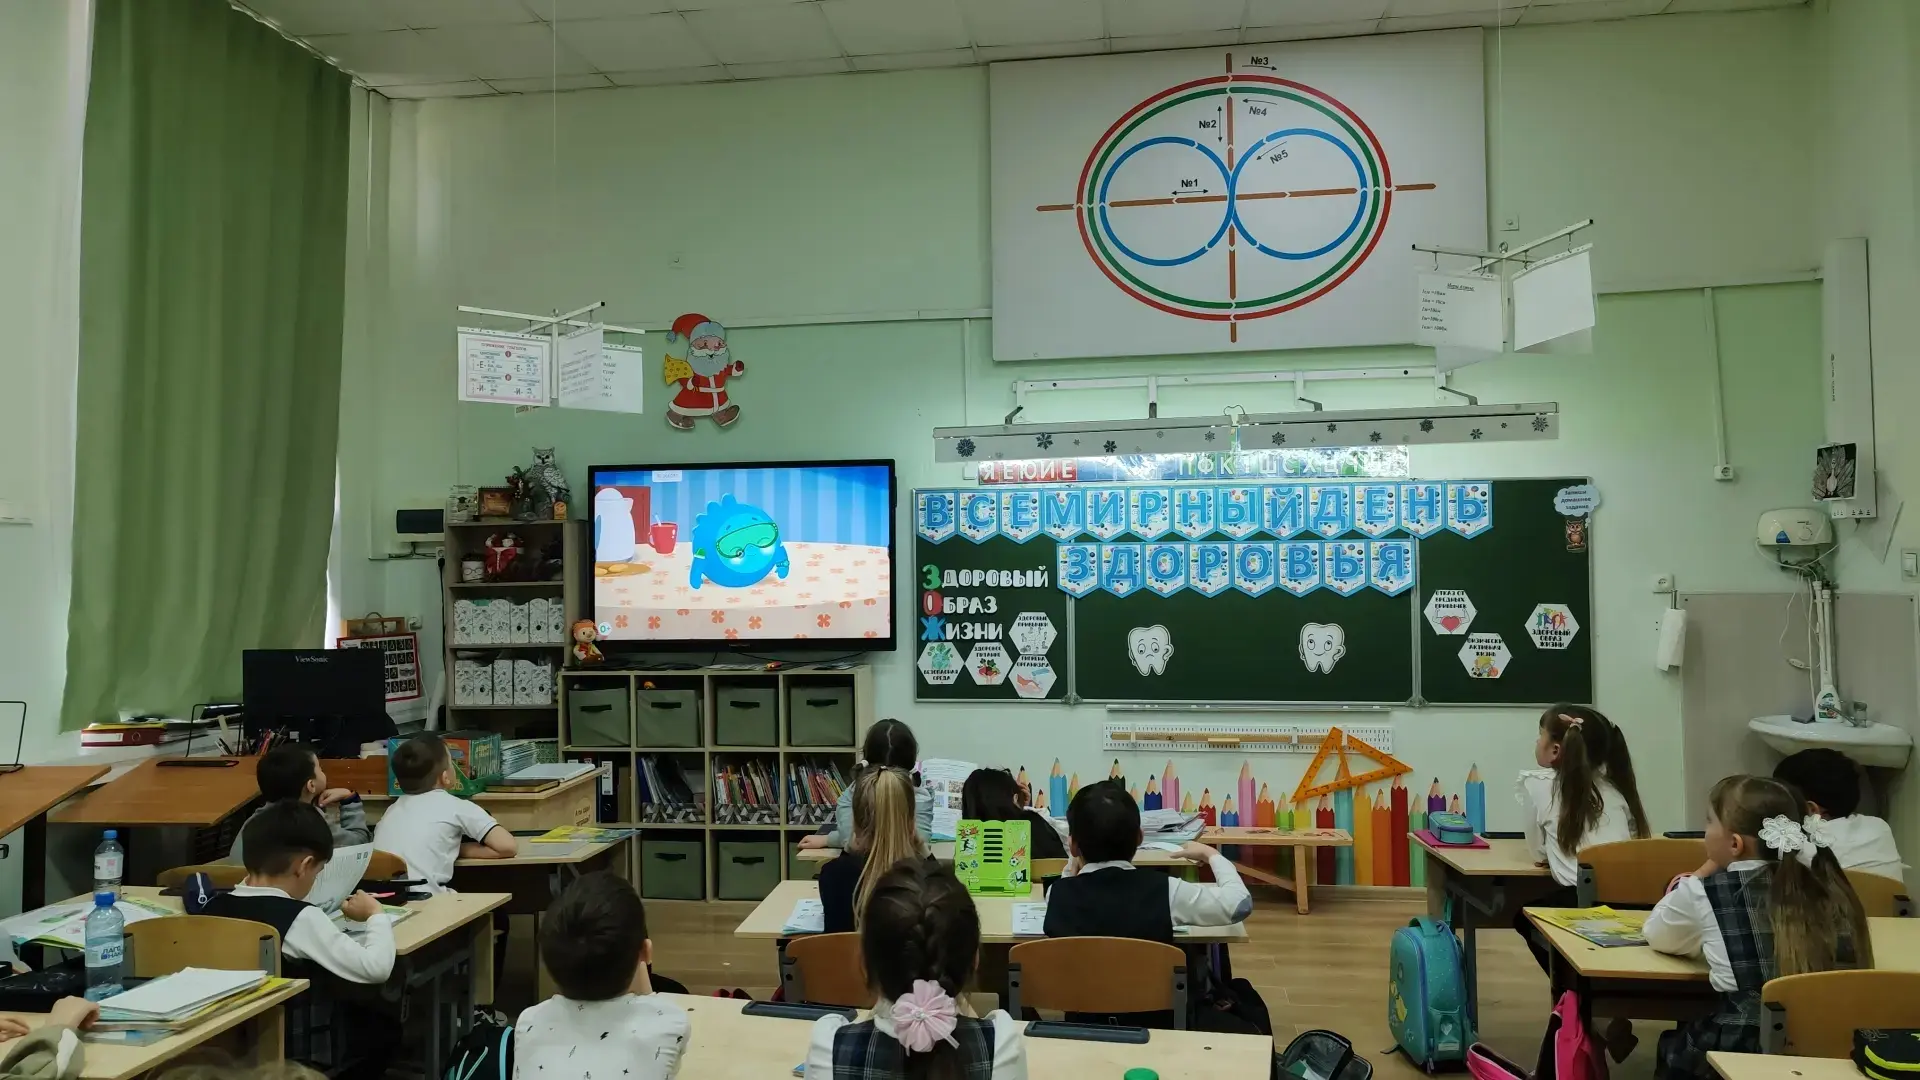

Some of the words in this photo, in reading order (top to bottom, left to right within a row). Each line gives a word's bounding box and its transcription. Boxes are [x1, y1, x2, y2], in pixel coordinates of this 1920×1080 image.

[1250, 56, 1269, 65] №3
[1249, 106, 1267, 116] №4
[1199, 120, 1217, 129] №2
[1269, 150, 1289, 164] №5
[1181, 179, 1199, 188] №1
[1065, 545, 1406, 589] ЗДОРОВЬЯ
[922, 564, 1049, 590] ЗДОРОВЫЙ
[922, 590, 998, 616] ОБРАЗ
[920, 615, 1003, 641] ЖИЗНИ
[295, 655, 329, 663] ViewSonic
